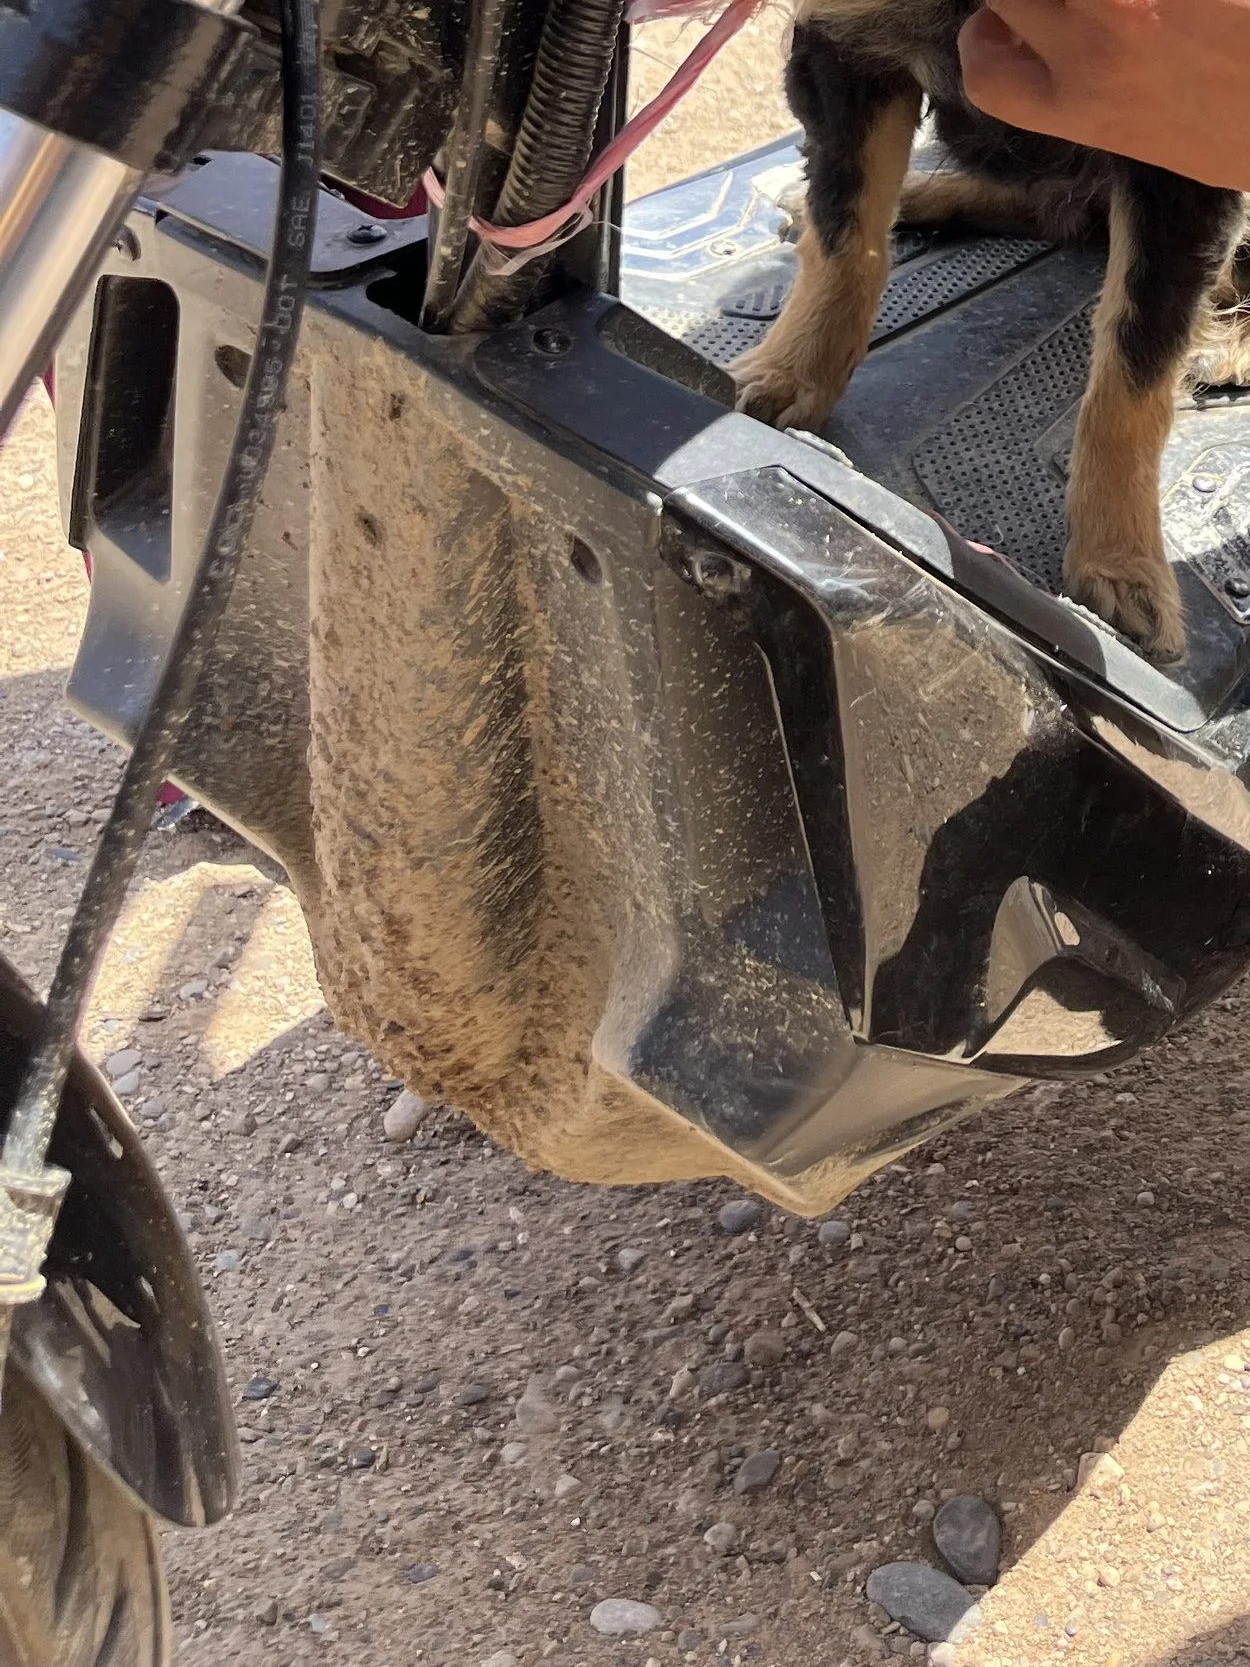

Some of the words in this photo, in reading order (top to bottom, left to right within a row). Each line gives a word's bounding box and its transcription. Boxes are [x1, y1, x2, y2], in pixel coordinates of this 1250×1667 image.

[297, 93, 318, 167] J1401
[287, 195, 311, 250] SAE
[270, 274, 298, 334] DOT
